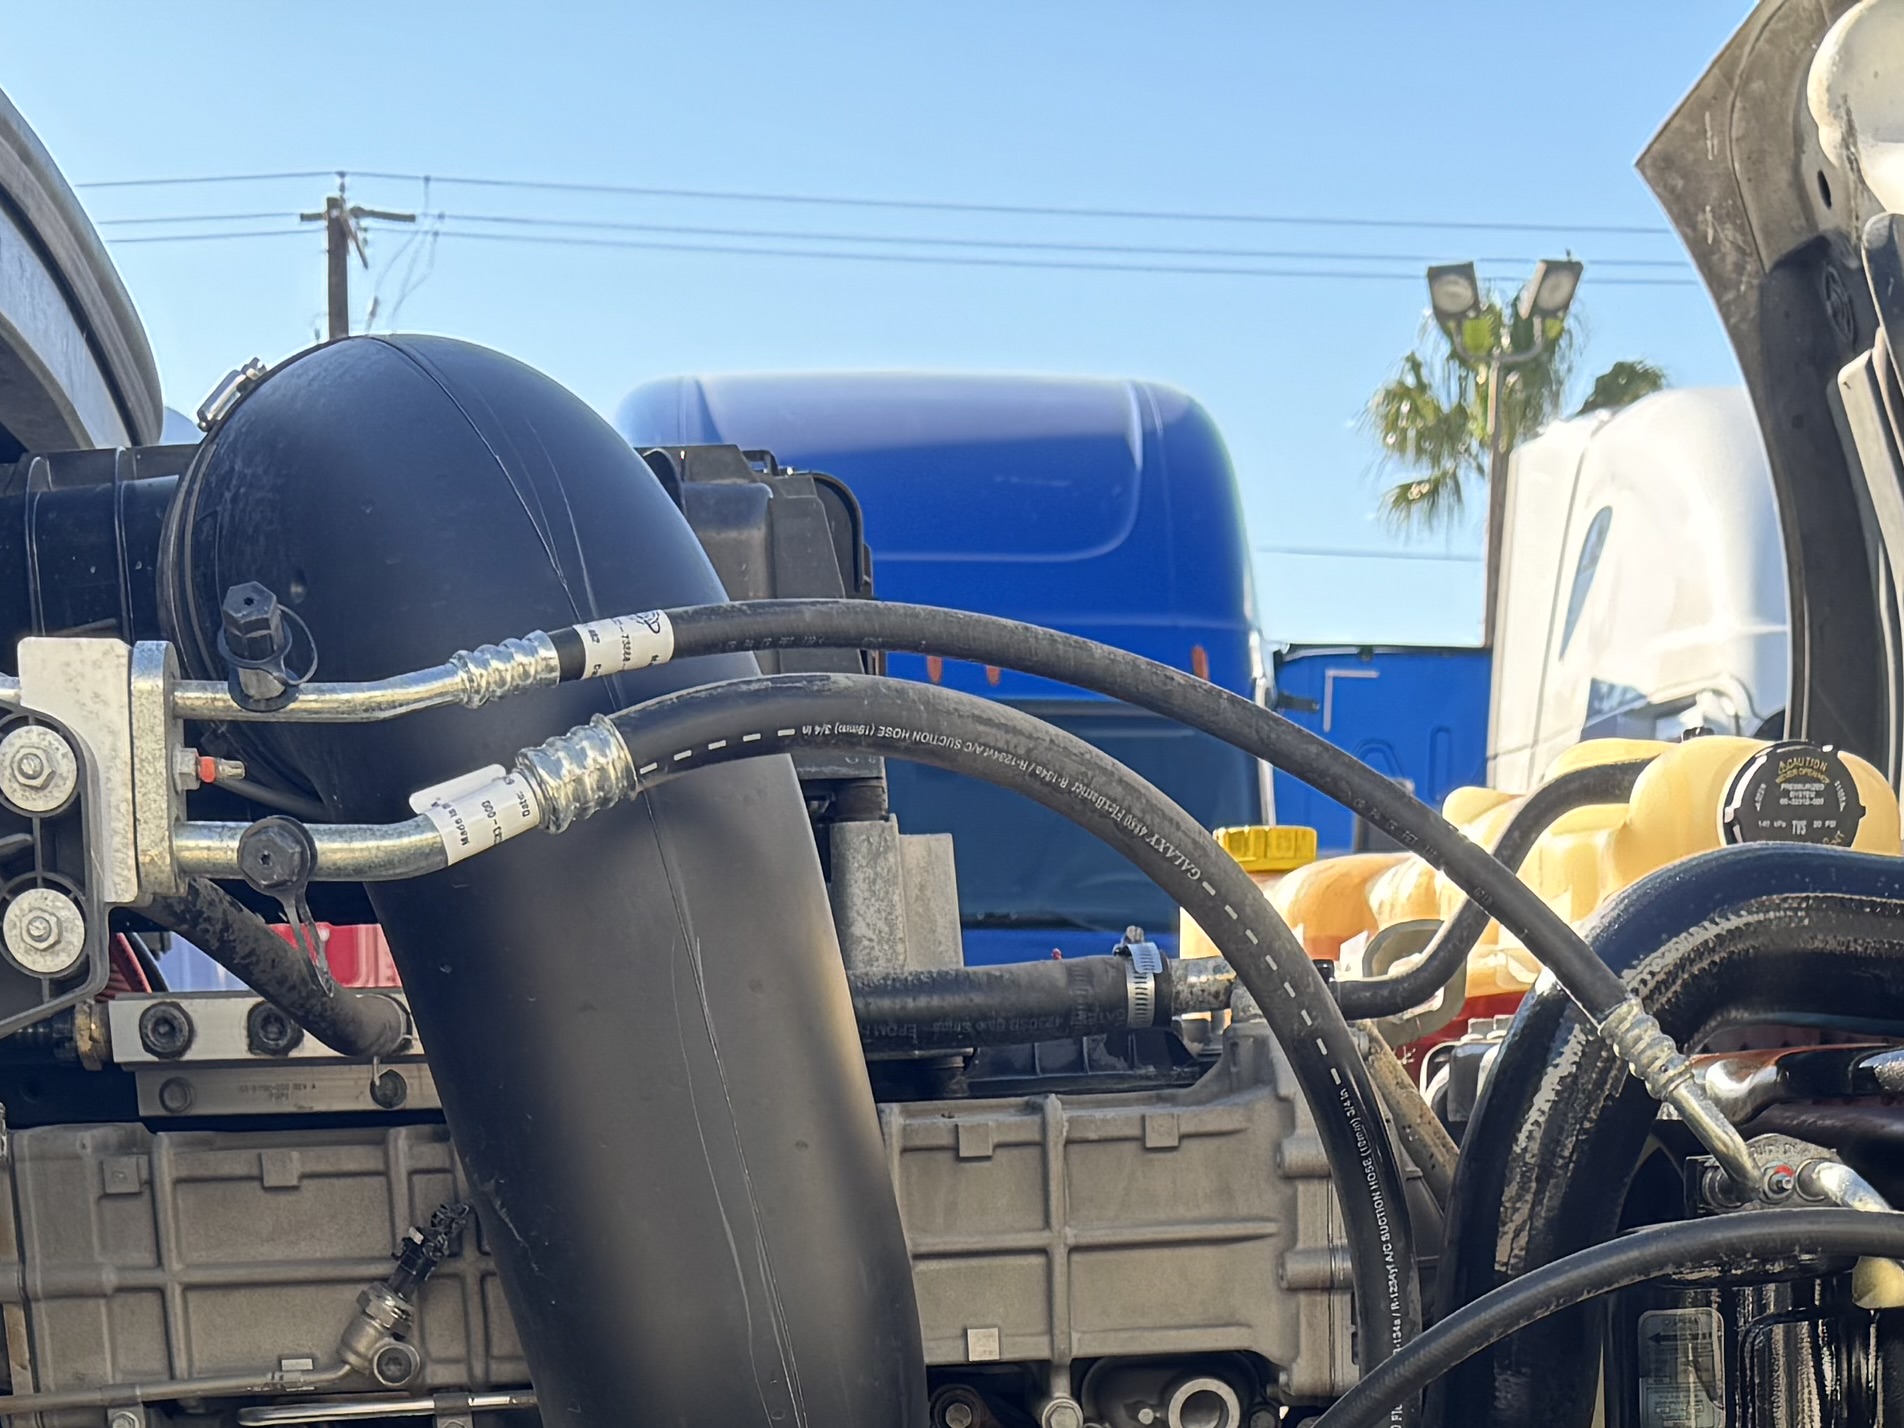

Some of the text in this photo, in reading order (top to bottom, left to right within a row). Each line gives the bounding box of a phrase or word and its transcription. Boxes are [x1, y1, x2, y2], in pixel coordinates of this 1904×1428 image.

[877, 726, 910, 739] HOSE
[912, 731, 962, 749] SUCTION
[1146, 832, 1201, 880] GALAXY
[1362, 1157, 1380, 1191] HOSE
[1372, 1190, 1391, 1242] SUCTION
